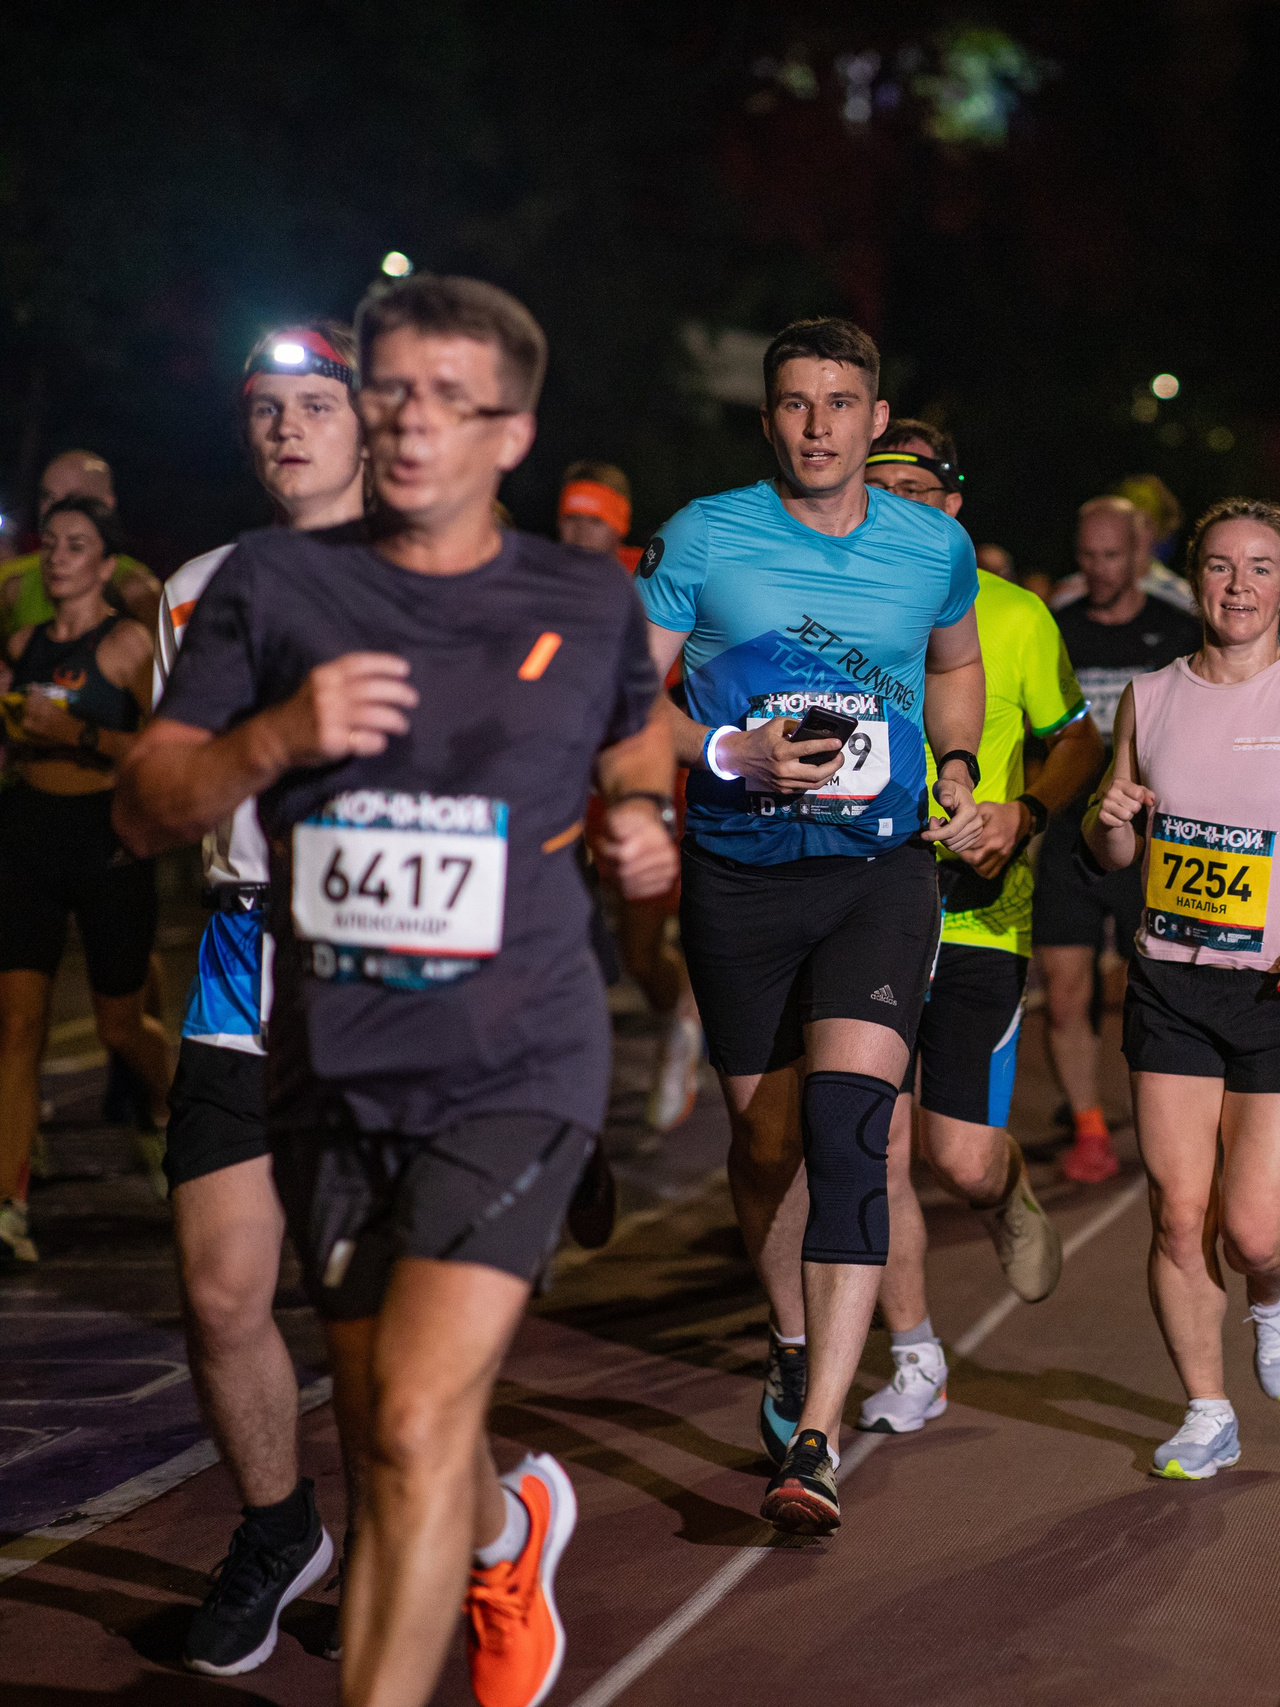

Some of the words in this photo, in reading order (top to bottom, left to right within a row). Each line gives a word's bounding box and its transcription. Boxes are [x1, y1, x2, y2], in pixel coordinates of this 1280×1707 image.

[769, 640, 837, 693] TEAM
[786, 614, 843, 652] JET
[837, 647, 916, 711] RUNNING
[760, 796, 776, 816] D
[1161, 816, 1265, 849] НОЧНОЙ
[322, 846, 474, 911] 6417
[1163, 852, 1252, 902] 7254
[1176, 895, 1227, 915] НАТАЛЬЯ
